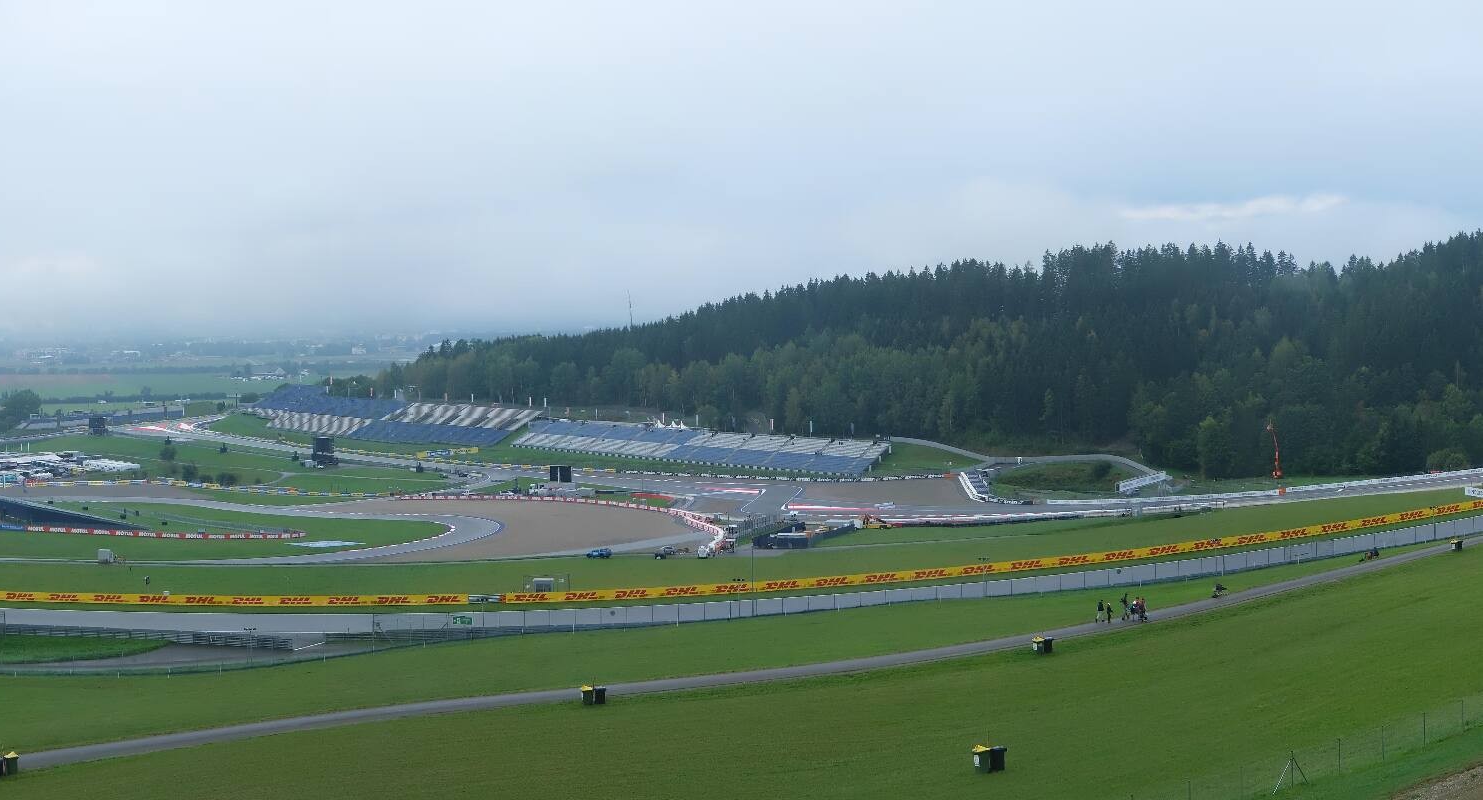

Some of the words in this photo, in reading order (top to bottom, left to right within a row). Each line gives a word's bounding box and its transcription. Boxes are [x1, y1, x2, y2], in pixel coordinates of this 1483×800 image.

[1436, 504, 1460, 514] DHL
[1400, 510, 1425, 520] DHL
[1361, 516, 1389, 526] DHL
[1321, 523, 1349, 532] DHL
[1281, 529, 1308, 538] DHL
[1237, 534, 1266, 544] DHL
[1194, 539, 1222, 549] DHL
[1149, 545, 1179, 555] DHL
[1104, 550, 1135, 560] DHL
[1010, 560, 1043, 570] DHL
[1058, 556, 1090, 565] DHL
[914, 569, 948, 579] DHL
[962, 565, 995, 574] DHL
[815, 577, 848, 586] DHL
[865, 573, 898, 582] DHL
[715, 584, 749, 592] DHL
[765, 581, 799, 590] DHL
[615, 589, 647, 598] DHL
[665, 586, 697, 595] DHL
[6, 592, 34, 600] DHL
[138, 595, 171, 604] DHL
[185, 596, 217, 604] DHL
[514, 593, 549, 601] DHL
[565, 592, 598, 600] DHL
[232, 597, 264, 605] DHL
